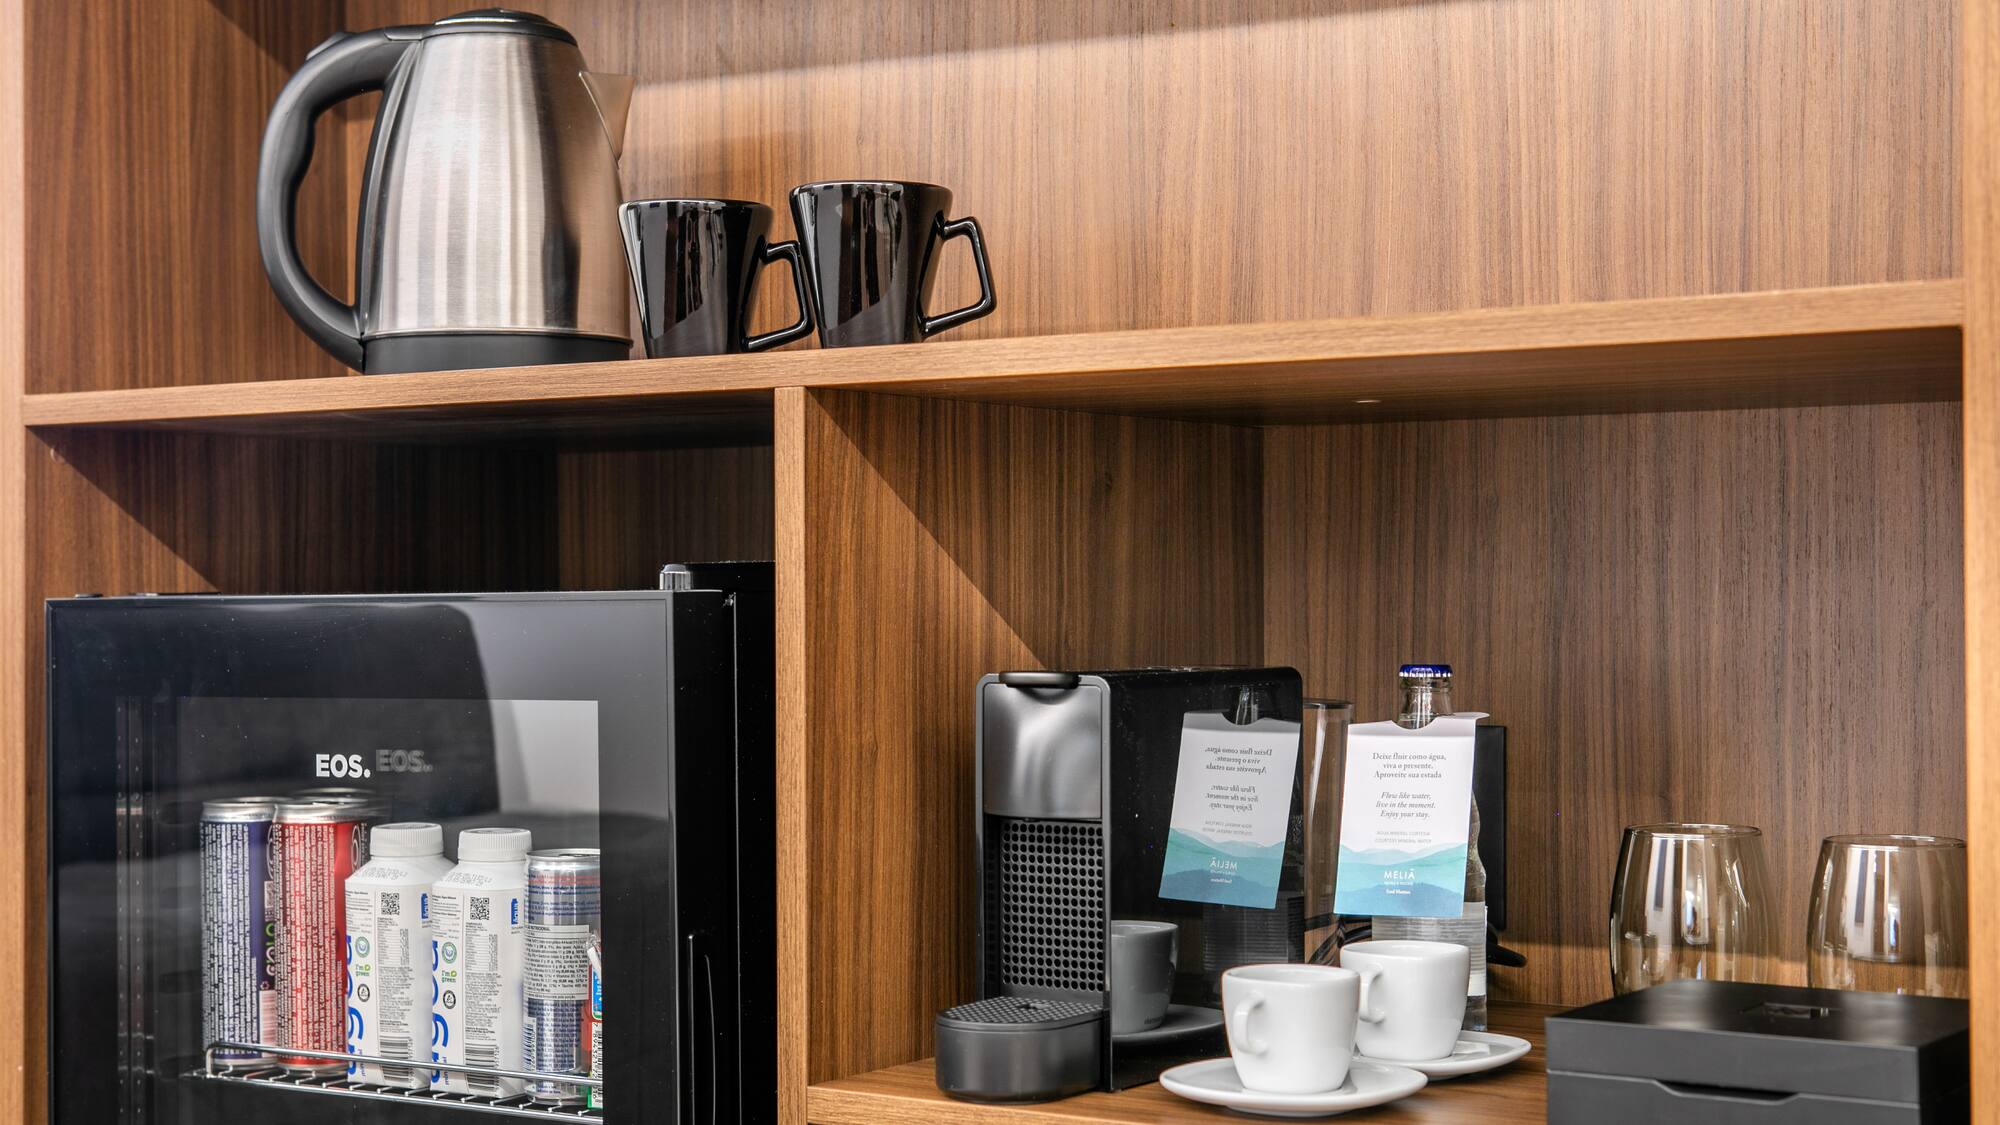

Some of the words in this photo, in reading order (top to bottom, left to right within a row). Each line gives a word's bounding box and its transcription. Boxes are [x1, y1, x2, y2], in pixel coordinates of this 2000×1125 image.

[1372, 752, 1393, 760] Deixe
[1393, 752, 1408, 760] fluir
[1428, 753, 1447, 761] água,
[315, 753, 371, 779] EOS.
[1374, 770, 1407, 780] Aproveite
[1420, 770, 1442, 778] estada
[1381, 791, 1398, 799] Flow
[1398, 791, 1410, 799] like
[1411, 792, 1432, 800] water,
[1375, 800, 1389, 808] live
[1380, 809, 1399, 819] Enjoy
[1415, 811, 1431, 820] stay.
